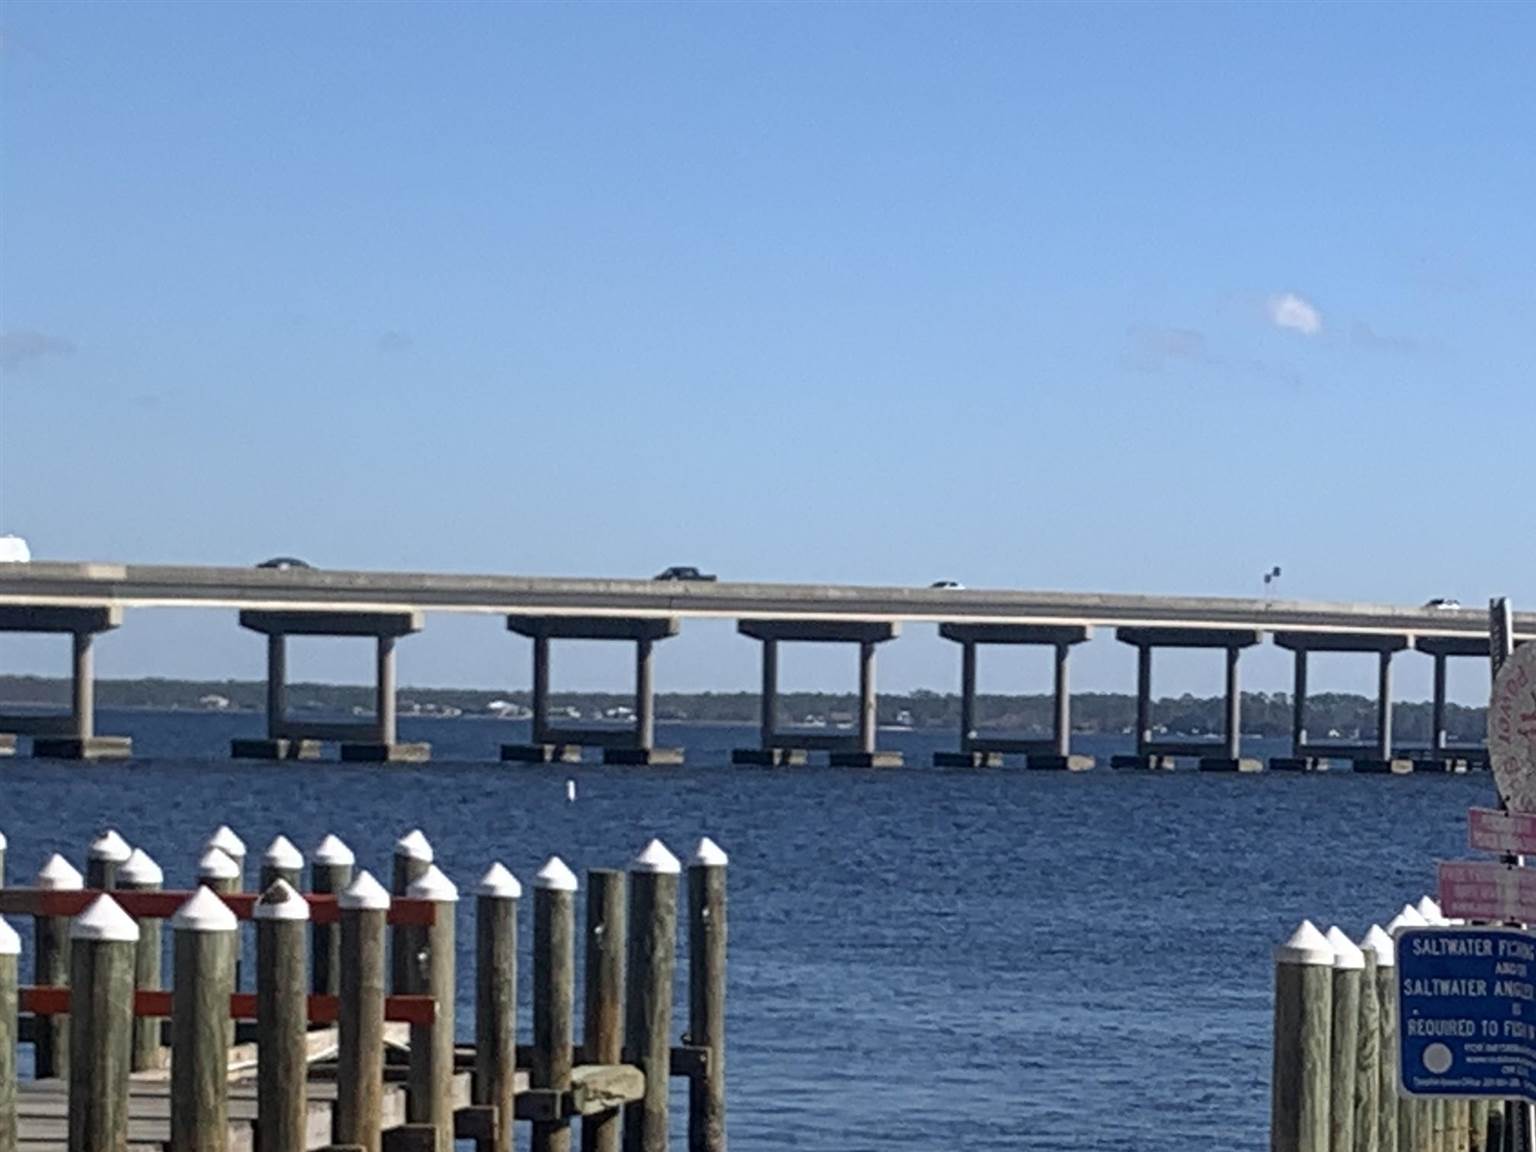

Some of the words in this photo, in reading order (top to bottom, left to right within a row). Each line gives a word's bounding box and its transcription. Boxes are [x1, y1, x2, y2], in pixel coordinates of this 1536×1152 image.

[1412, 938, 1493, 956] SALTWATER
[1403, 978, 1488, 997] SALTWATER
[1407, 1018, 1476, 1037] REQUIRED
[1481, 1019, 1499, 1037] TO
